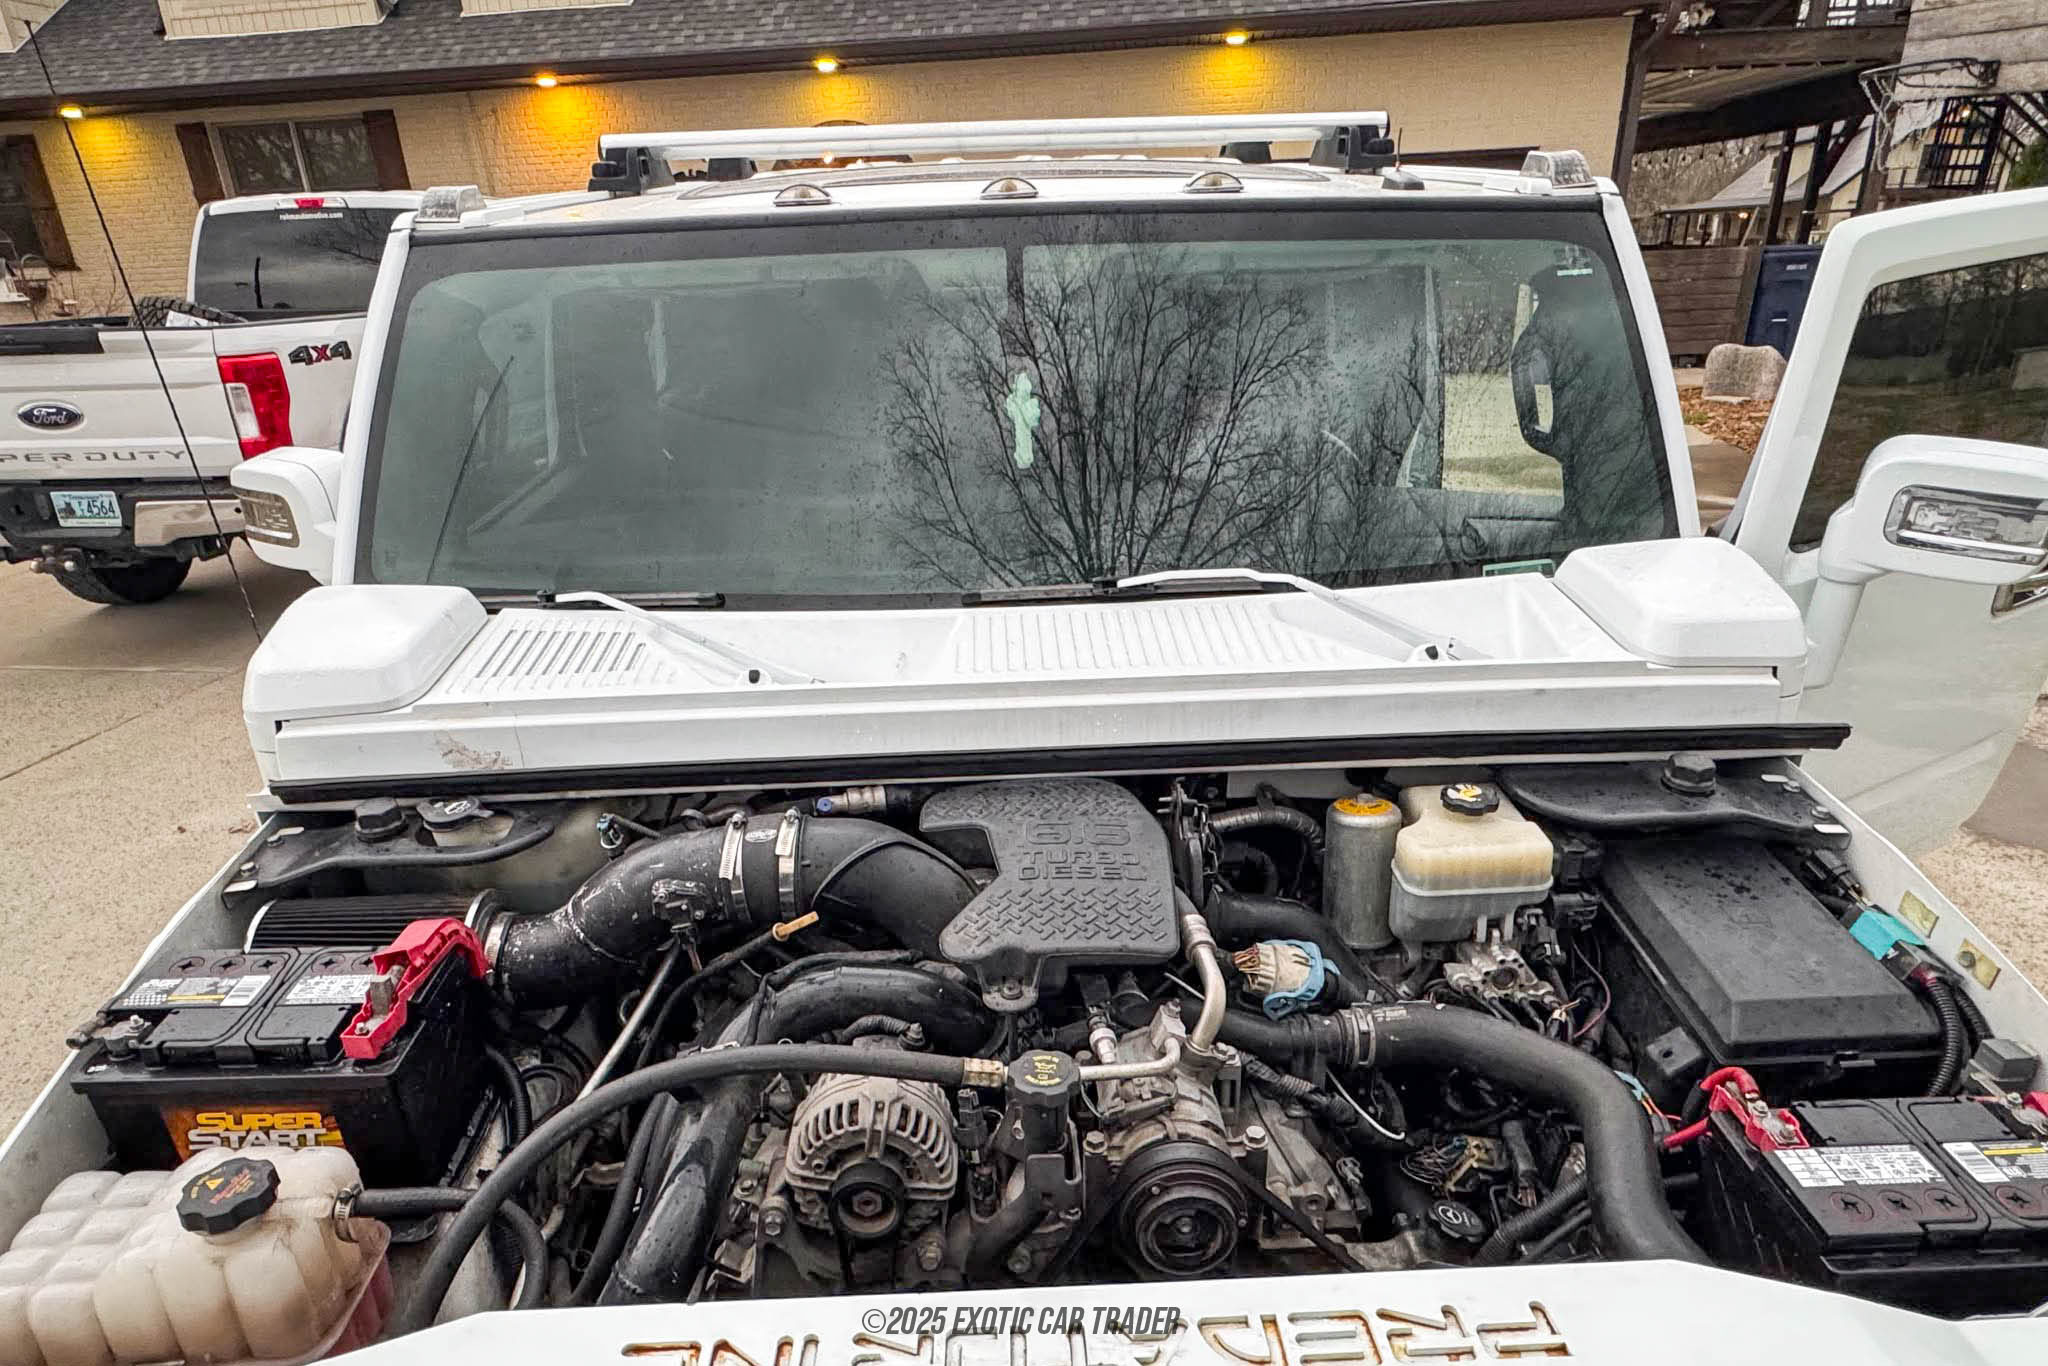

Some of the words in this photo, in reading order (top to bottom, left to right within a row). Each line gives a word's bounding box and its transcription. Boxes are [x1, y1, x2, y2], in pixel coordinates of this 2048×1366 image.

[32, 407, 69, 425] Ford
[83, 450, 186, 462] DUTY
[86, 499, 116, 516] 4564
[1022, 850, 1141, 866] TURBO
[1017, 865, 1148, 881] DIESEL
[196, 1111, 322, 1132] SUPER
[187, 1127, 327, 1151] START
